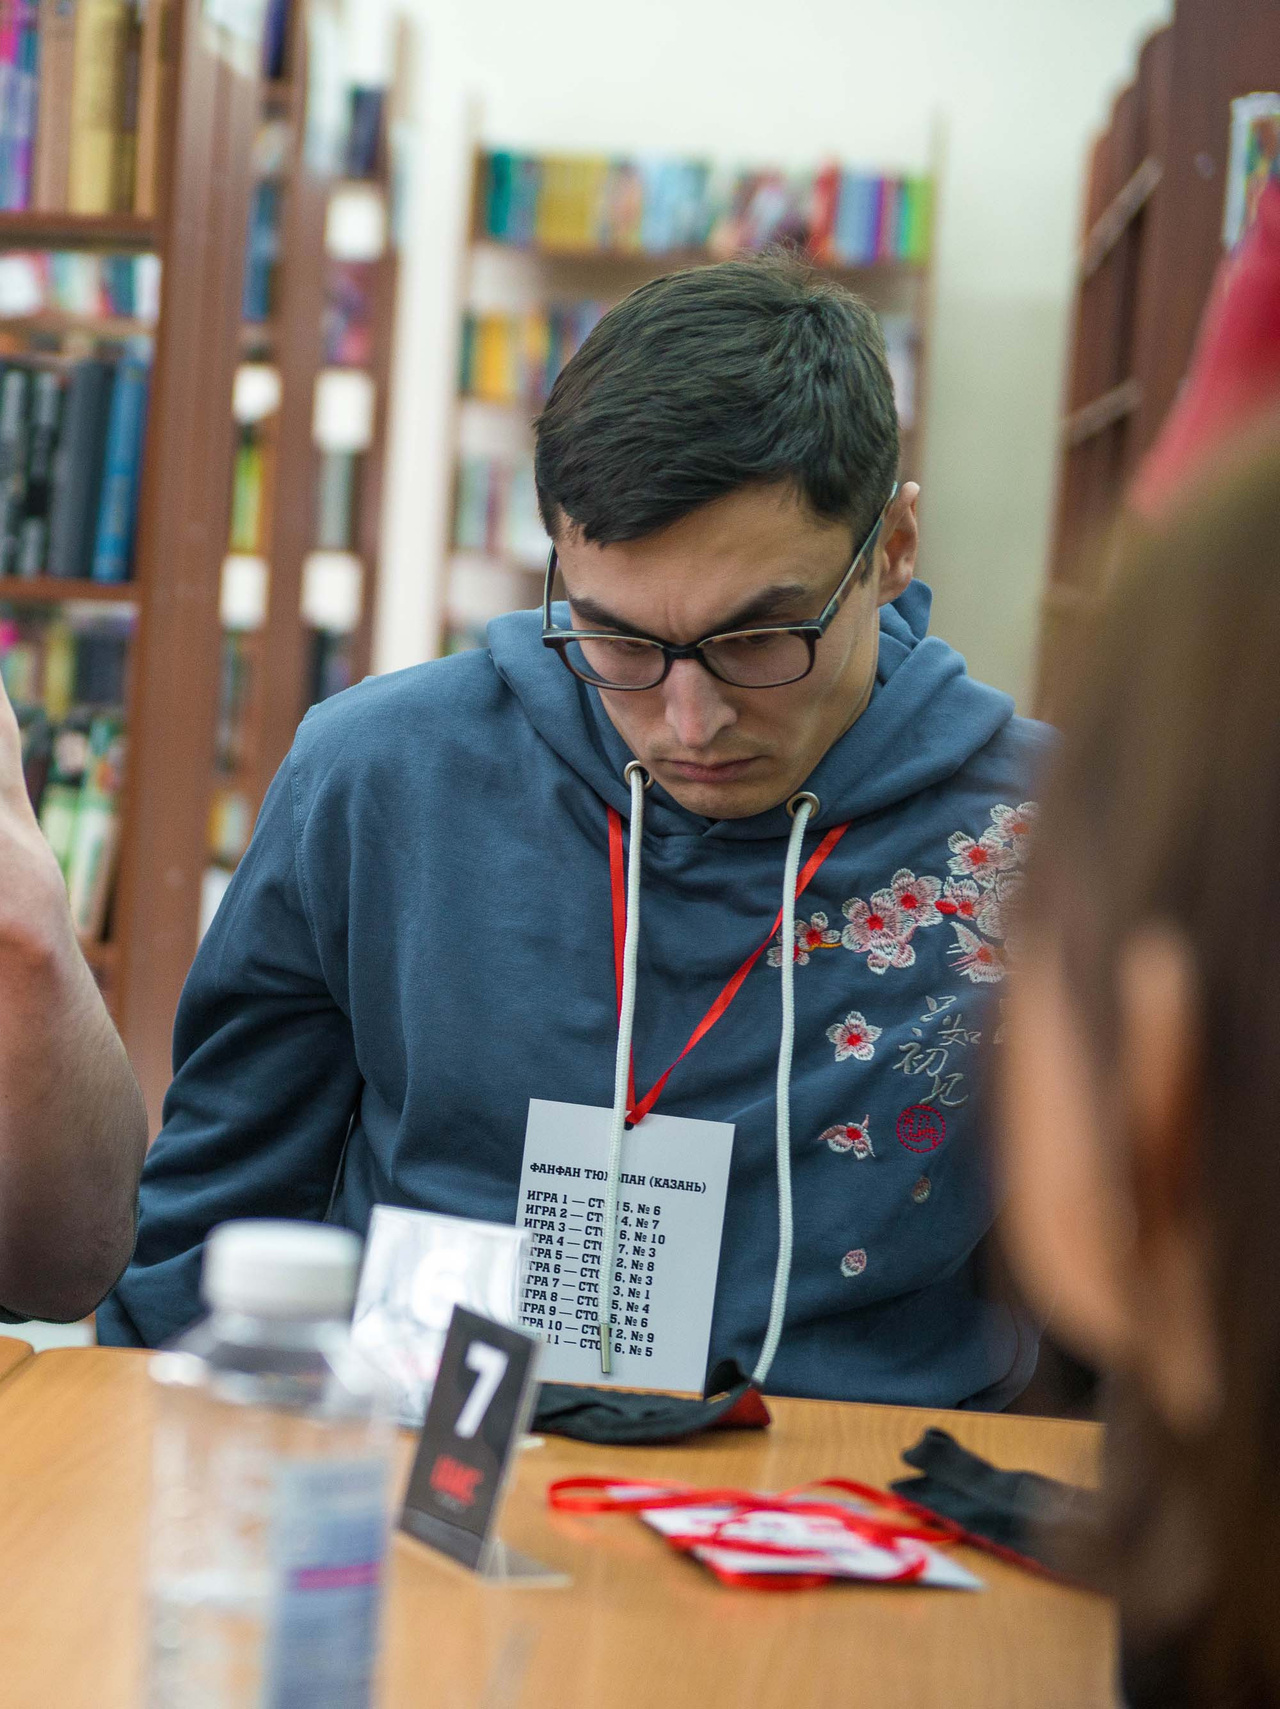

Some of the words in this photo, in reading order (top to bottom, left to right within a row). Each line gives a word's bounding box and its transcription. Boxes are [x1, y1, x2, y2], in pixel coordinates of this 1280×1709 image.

[530, 1163, 581, 1178] ФАНФАН
[584, 1168, 646, 1186] ТЮПАН
[649, 1176, 707, 1194] (КАЗАНЬ)
[527, 1190, 558, 1204] ИГРА
[562, 1194, 568, 1204] 1
[637, 1203, 650, 1215] №
[653, 1206, 662, 1216] 6
[525, 1204, 557, 1217] ИГРА
[560, 1208, 568, 1218] 2
[636, 1218, 648, 1229] №
[652, 1220, 660, 1230] 7
[524, 1218, 555, 1231] ИГРА
[558, 1222, 566, 1232] 3
[634, 1232, 647, 1243] №
[650, 1234, 666, 1245] 10
[532, 1232, 554, 1245] ГРА
[556, 1236, 564, 1247] 4
[632, 1245, 646, 1257] №
[648, 1247, 656, 1258] 3
[529, 1246, 552, 1259] ГРА
[555, 1250, 563, 1260] 5
[630, 1260, 644, 1271] №
[646, 1262, 654, 1272] 8
[528, 1260, 550, 1273] ГРА
[554, 1264, 562, 1274] 6
[629, 1274, 642, 1284] №
[645, 1276, 653, 1286] 3
[525, 1274, 548, 1287] ГРА
[552, 1278, 560, 1288] 7
[628, 1288, 641, 1298] №
[644, 1290, 650, 1300] 1
[522, 1288, 548, 1301] ГРА
[550, 1292, 558, 1302] 8
[626, 1302, 639, 1312] №
[642, 1304, 650, 1314] 4
[521, 1302, 546, 1315] ГРА
[548, 1306, 556, 1316] 9
[624, 1316, 638, 1327] №
[640, 1318, 648, 1328] 6
[520, 1316, 544, 1329] ГРА
[548, 1320, 562, 1331] 10
[630, 1330, 644, 1342] №
[646, 1332, 654, 1343] 9
[628, 1344, 642, 1356] №
[645, 1346, 653, 1357] 5
[454, 1339, 510, 1439] 7
